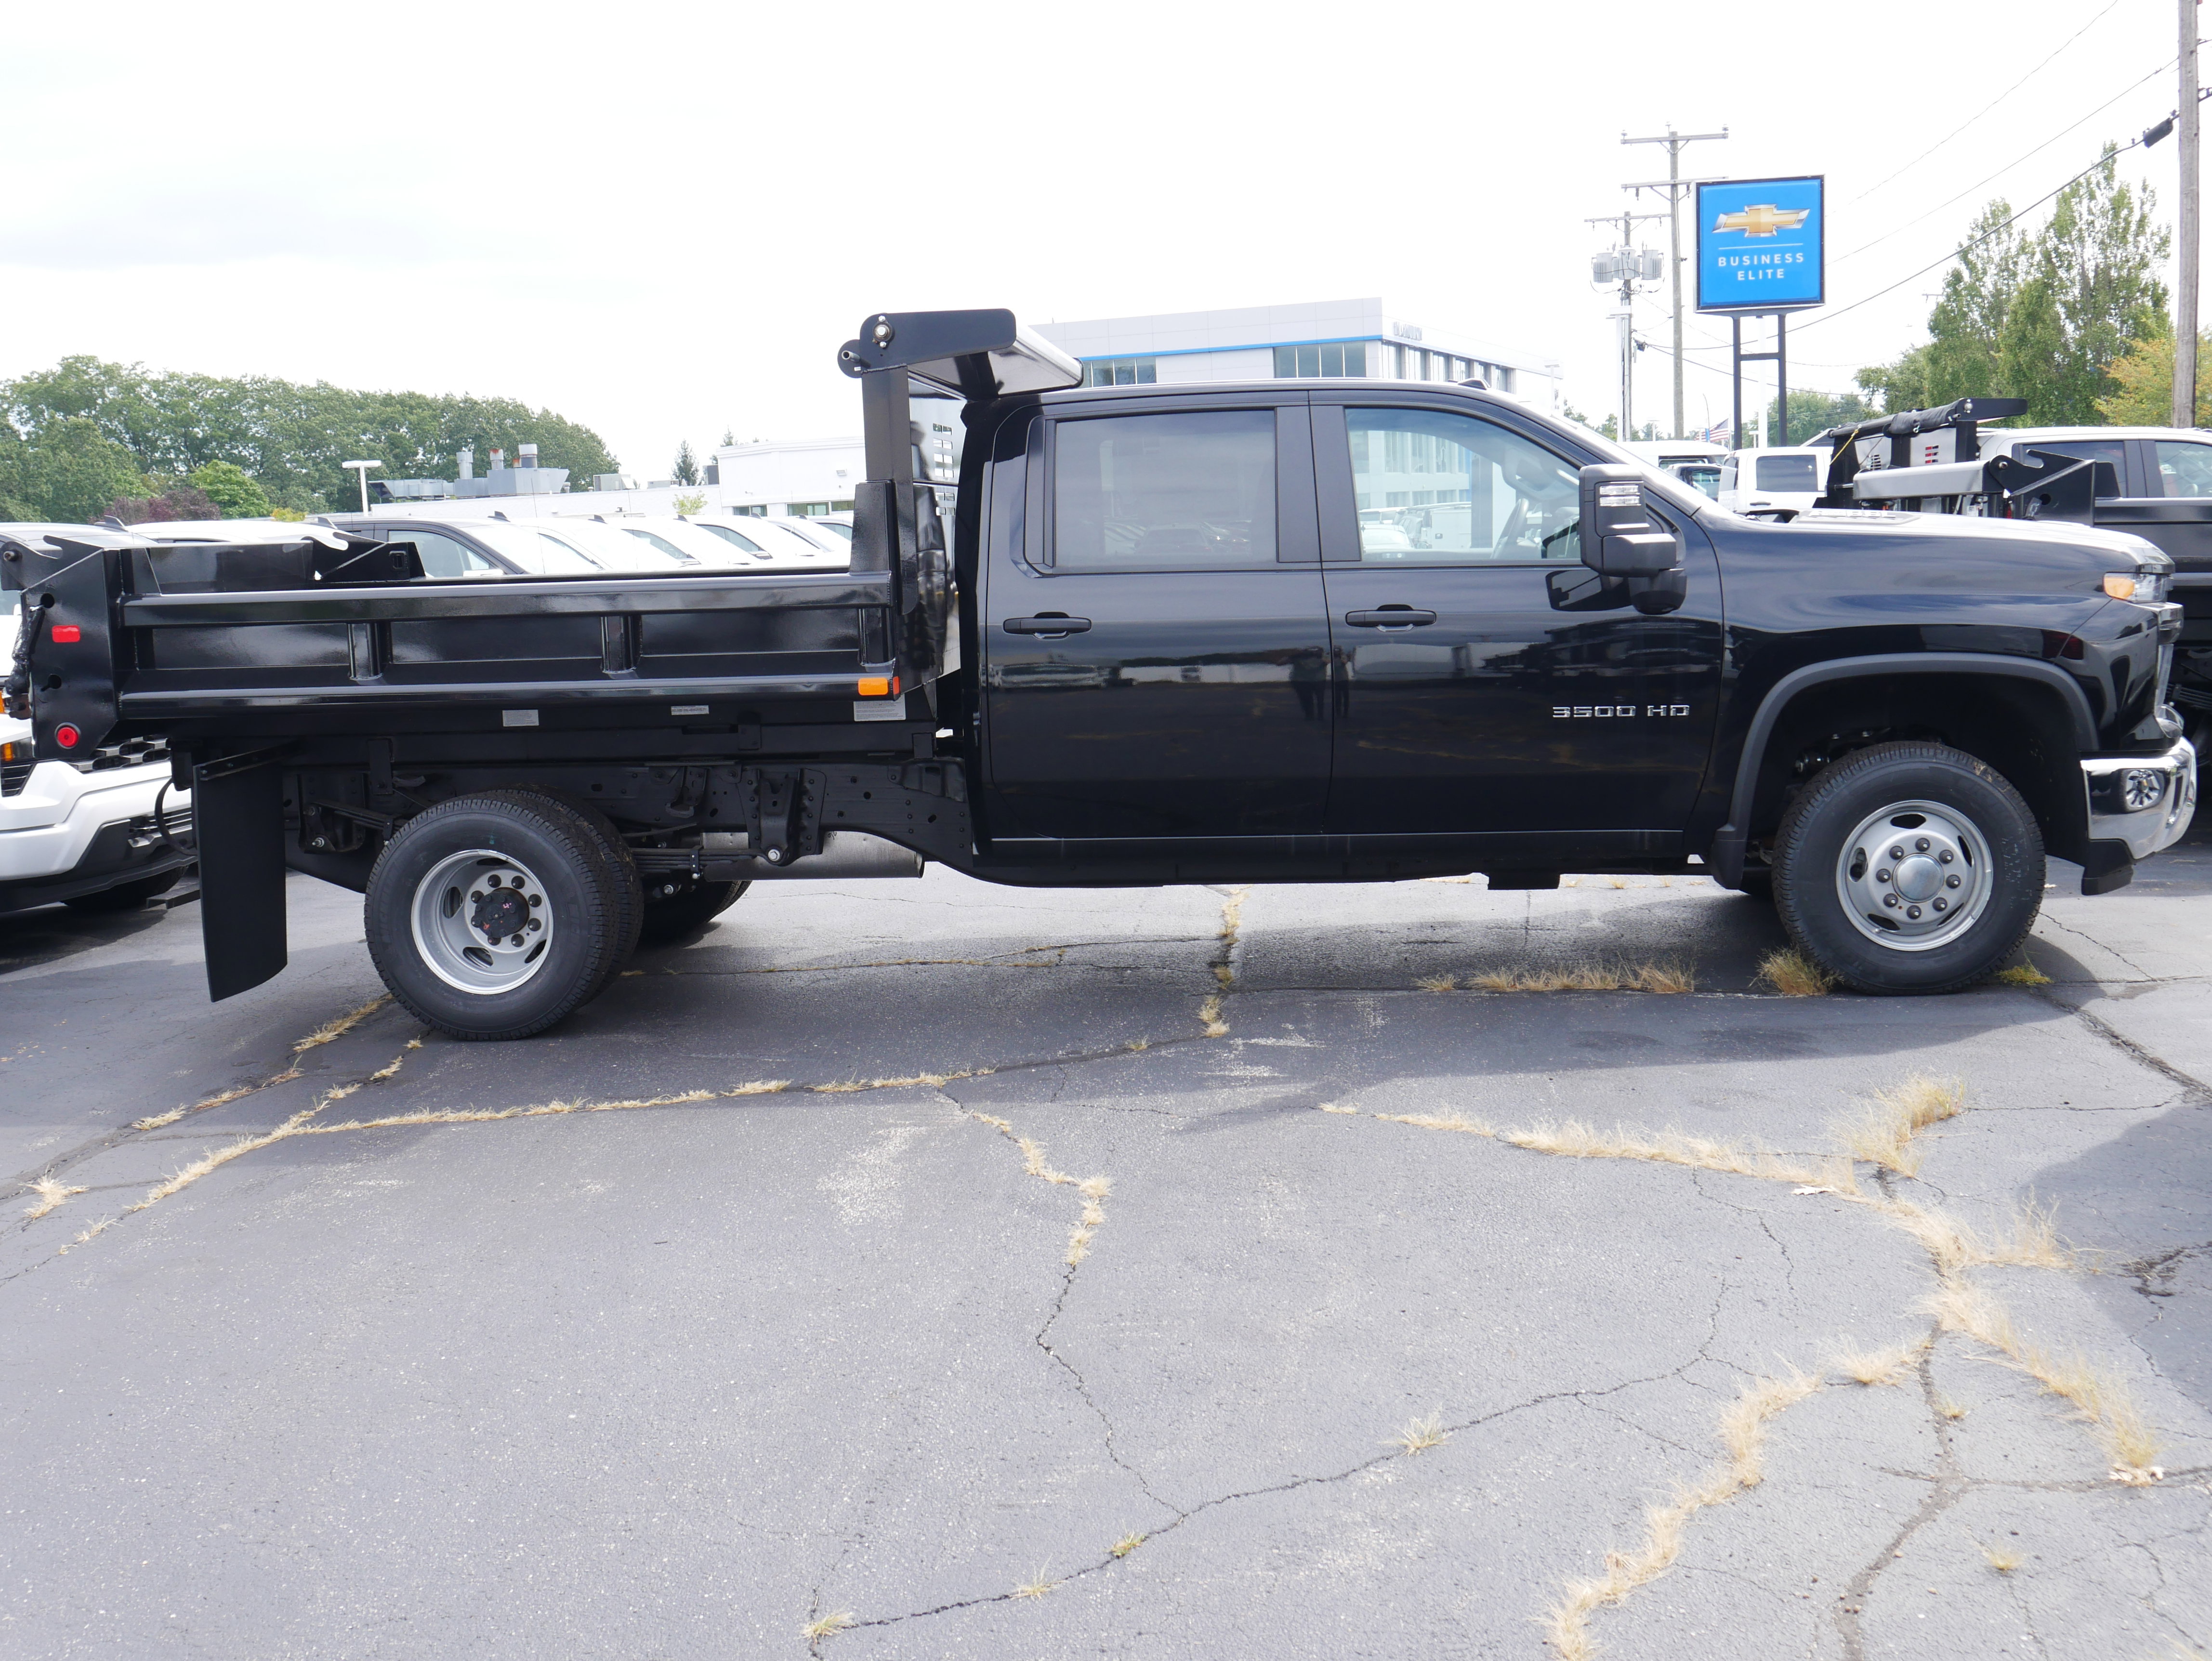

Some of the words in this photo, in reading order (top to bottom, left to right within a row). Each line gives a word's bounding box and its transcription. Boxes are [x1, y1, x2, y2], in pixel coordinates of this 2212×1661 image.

[1718, 253, 1804, 267] BUSINESS
[1737, 268, 1785, 280] ELITE
[1552, 705, 1636, 718] 3500
[1647, 704, 1690, 717] HD
